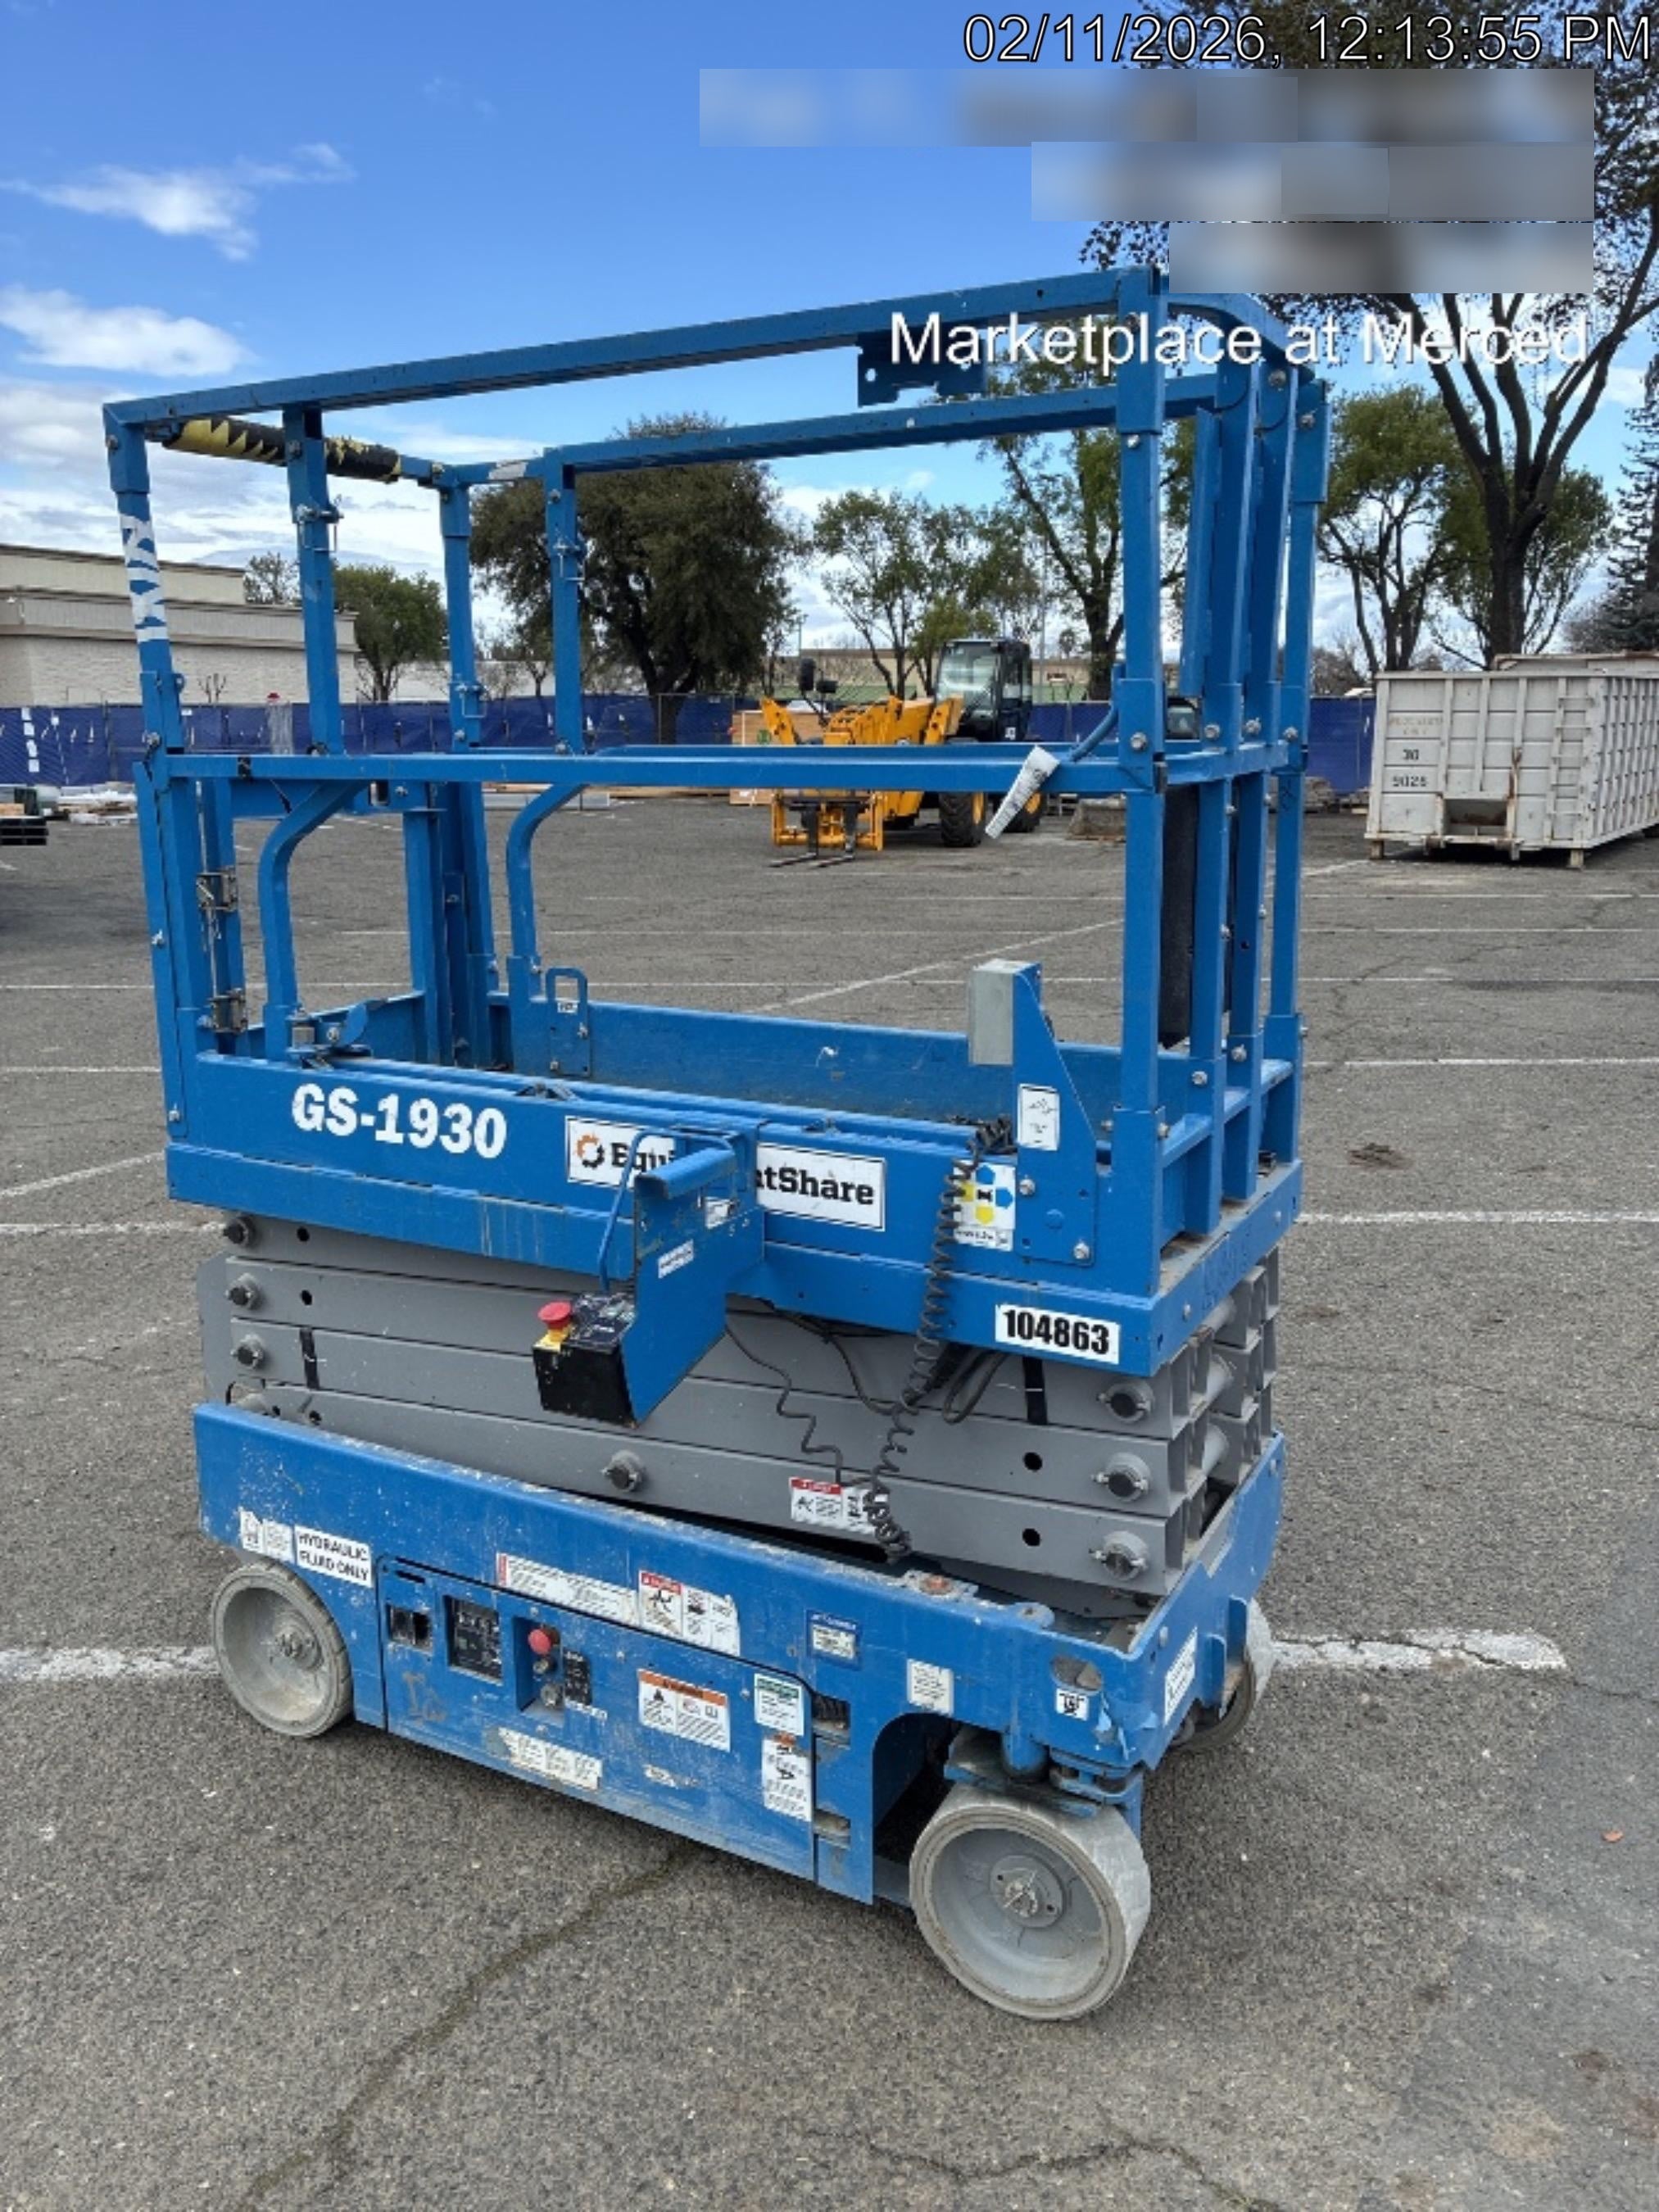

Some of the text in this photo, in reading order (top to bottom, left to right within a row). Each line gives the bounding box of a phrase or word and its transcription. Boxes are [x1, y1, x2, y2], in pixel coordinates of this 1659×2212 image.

[292, 1082, 507, 1159] GS-1930
[1002, 1308, 1110, 1355] 104863
[298, 1532, 369, 1562] HYDRAULIC
[336, 1559, 369, 1582] ONLY
